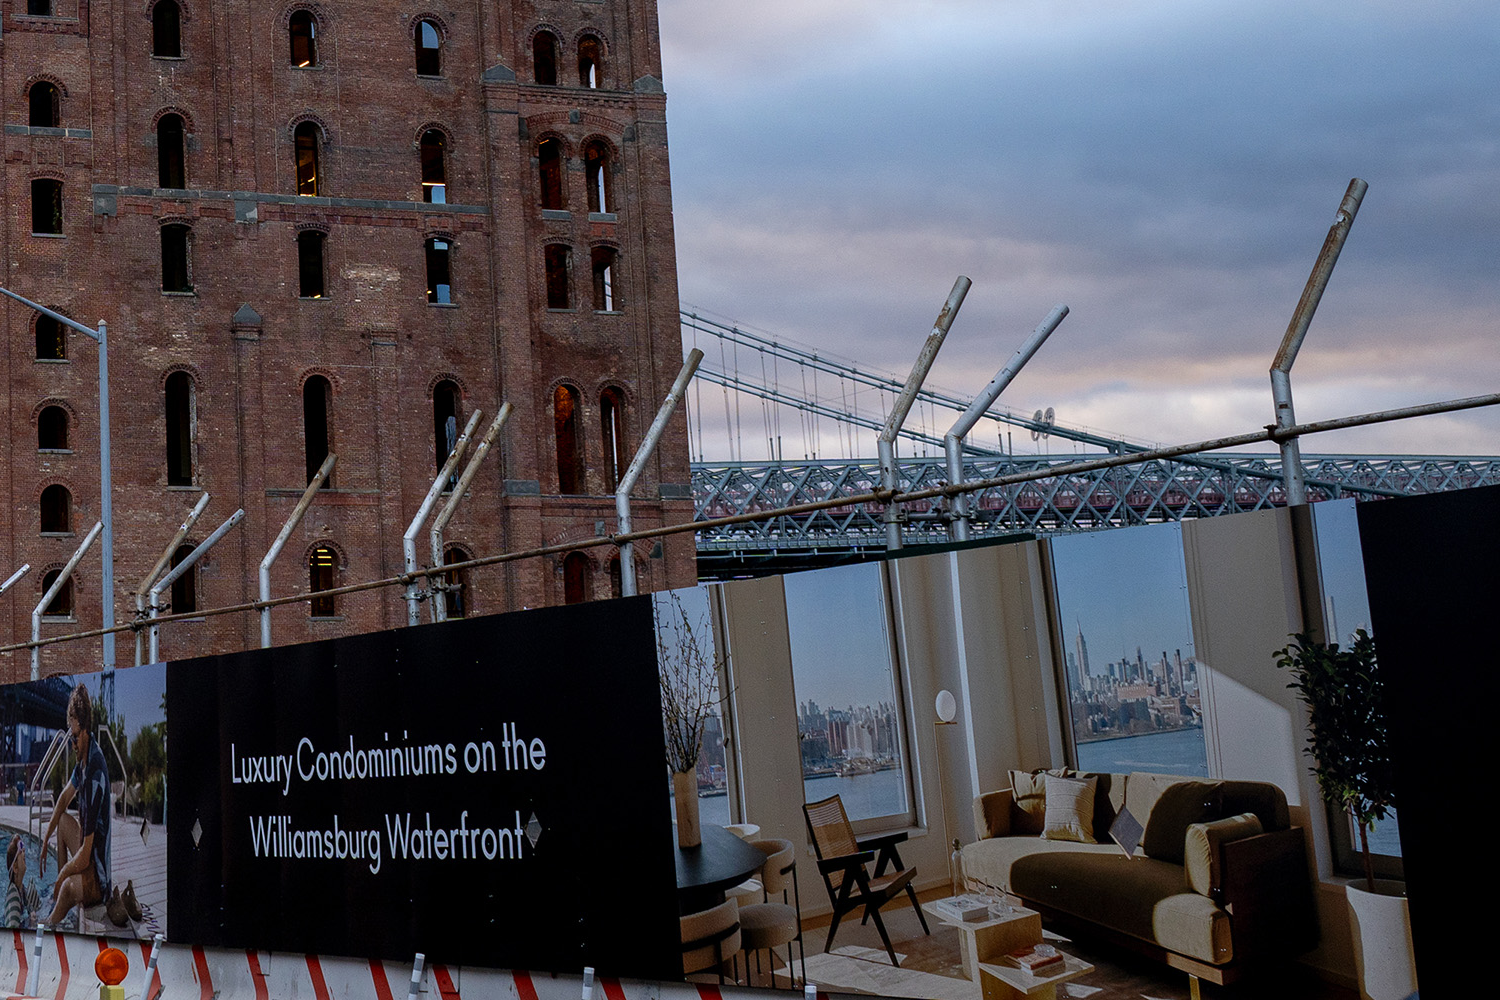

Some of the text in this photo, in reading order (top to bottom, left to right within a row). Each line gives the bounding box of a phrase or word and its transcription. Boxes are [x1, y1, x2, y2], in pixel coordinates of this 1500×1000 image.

[231, 721, 546, 796] Luxury Condominiums on the
[249, 810, 524, 875] Williamsburg Waterfront
